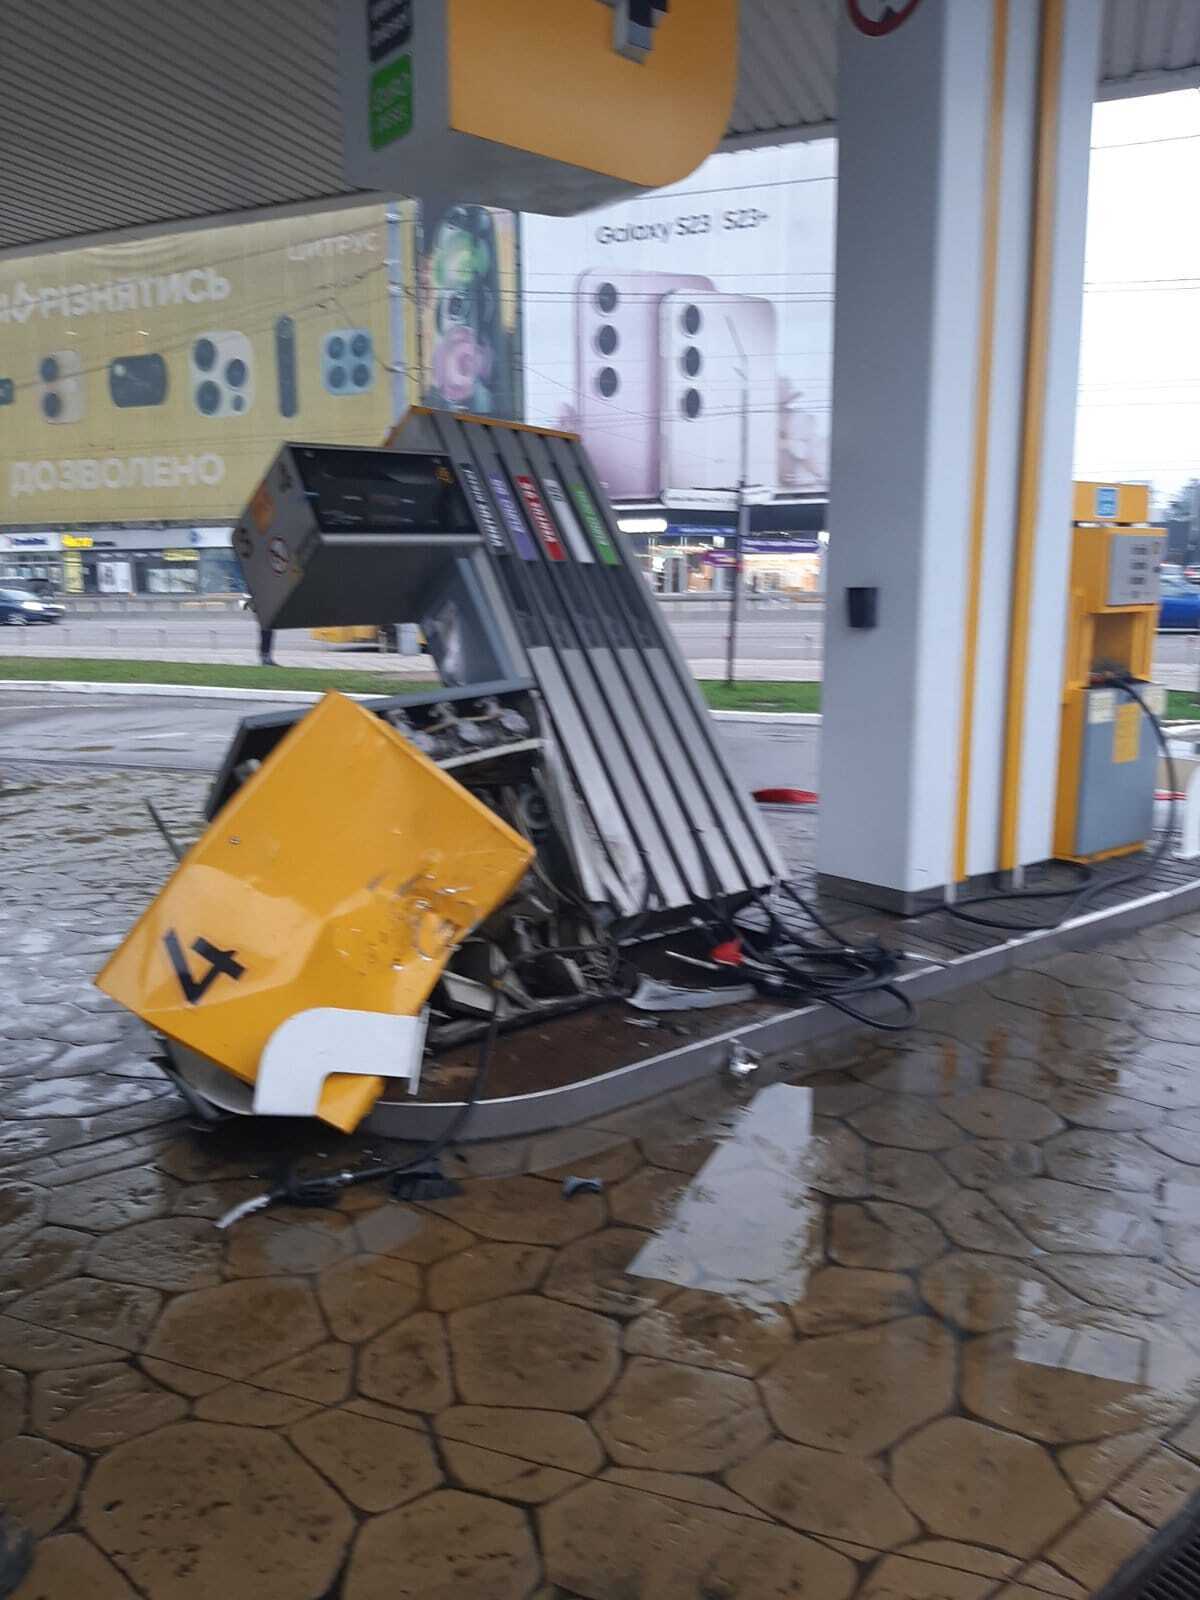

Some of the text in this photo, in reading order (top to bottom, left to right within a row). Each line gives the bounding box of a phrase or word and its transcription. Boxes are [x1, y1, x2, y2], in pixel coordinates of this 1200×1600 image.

[594, 207, 769, 245] Galaxy S23 S23+
[10, 454, 224, 495] ДОЗВОЛЕНО
[163, 928, 246, 1005] 4
